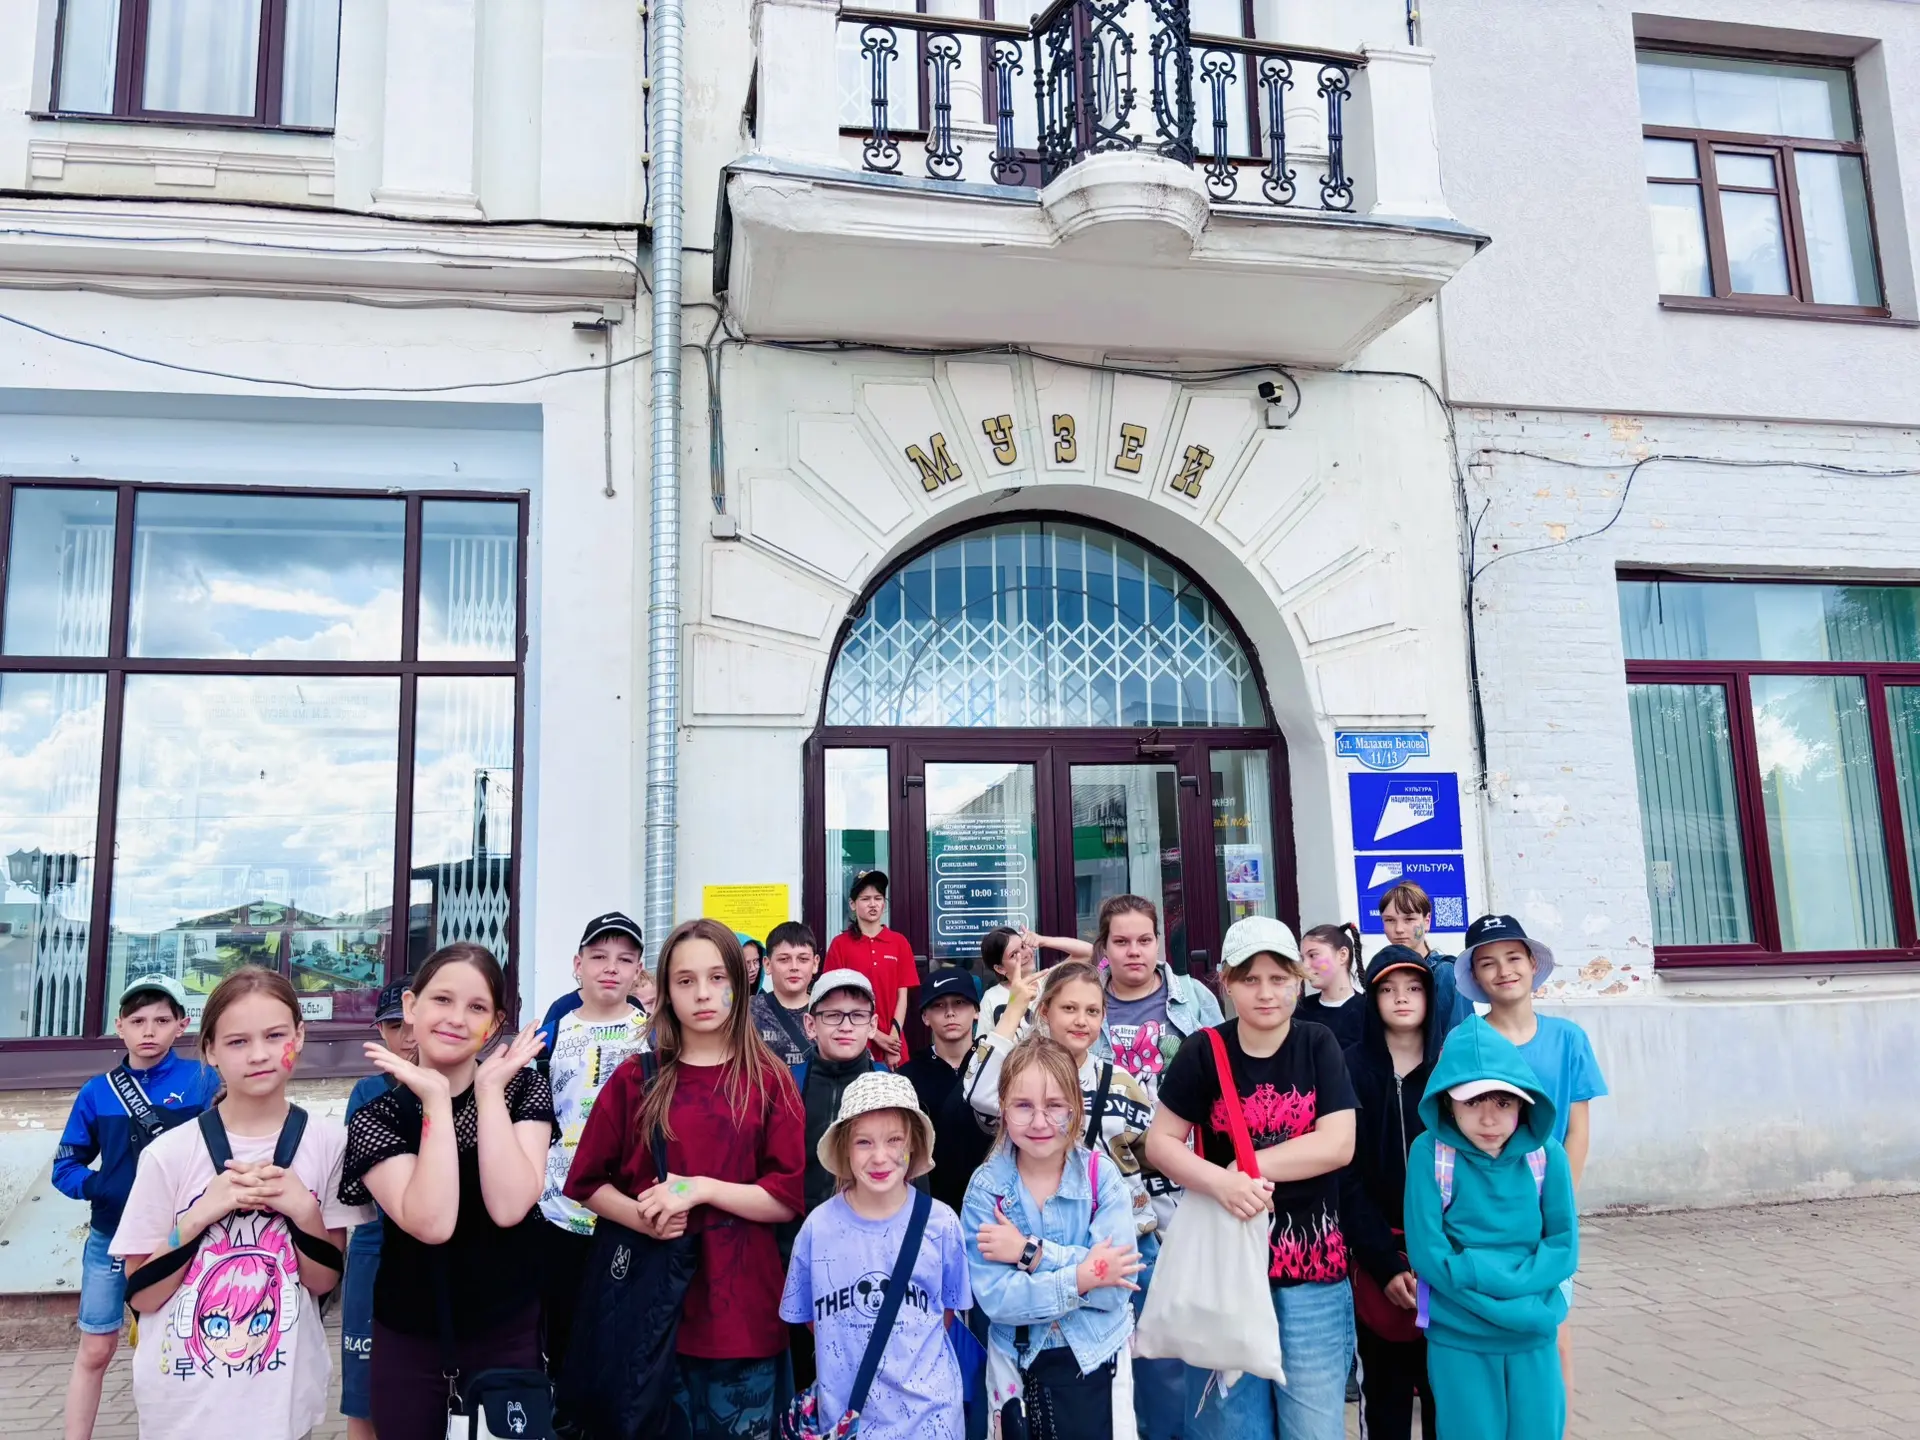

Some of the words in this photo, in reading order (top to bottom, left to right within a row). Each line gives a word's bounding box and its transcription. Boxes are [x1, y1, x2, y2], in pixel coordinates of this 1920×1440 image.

[905, 413, 1215, 499] МУЗЕЙ
[1339, 740, 1353, 752] ул.
[1355, 737, 1393, 749] Малахия
[1395, 737, 1425, 749] Белова
[1371, 750, 1399, 765] 11/13
[1390, 796, 1432, 804] НАЦИОНАЛЬНЫЕ
[1406, 863, 1455, 873] КУЛЬТУРА
[970, 889, 992, 897] 10:00
[1000, 888, 1021, 897] 18:00
[981, 919, 998, 927] 10:00
[345, 1335, 373, 1352] BLAC
